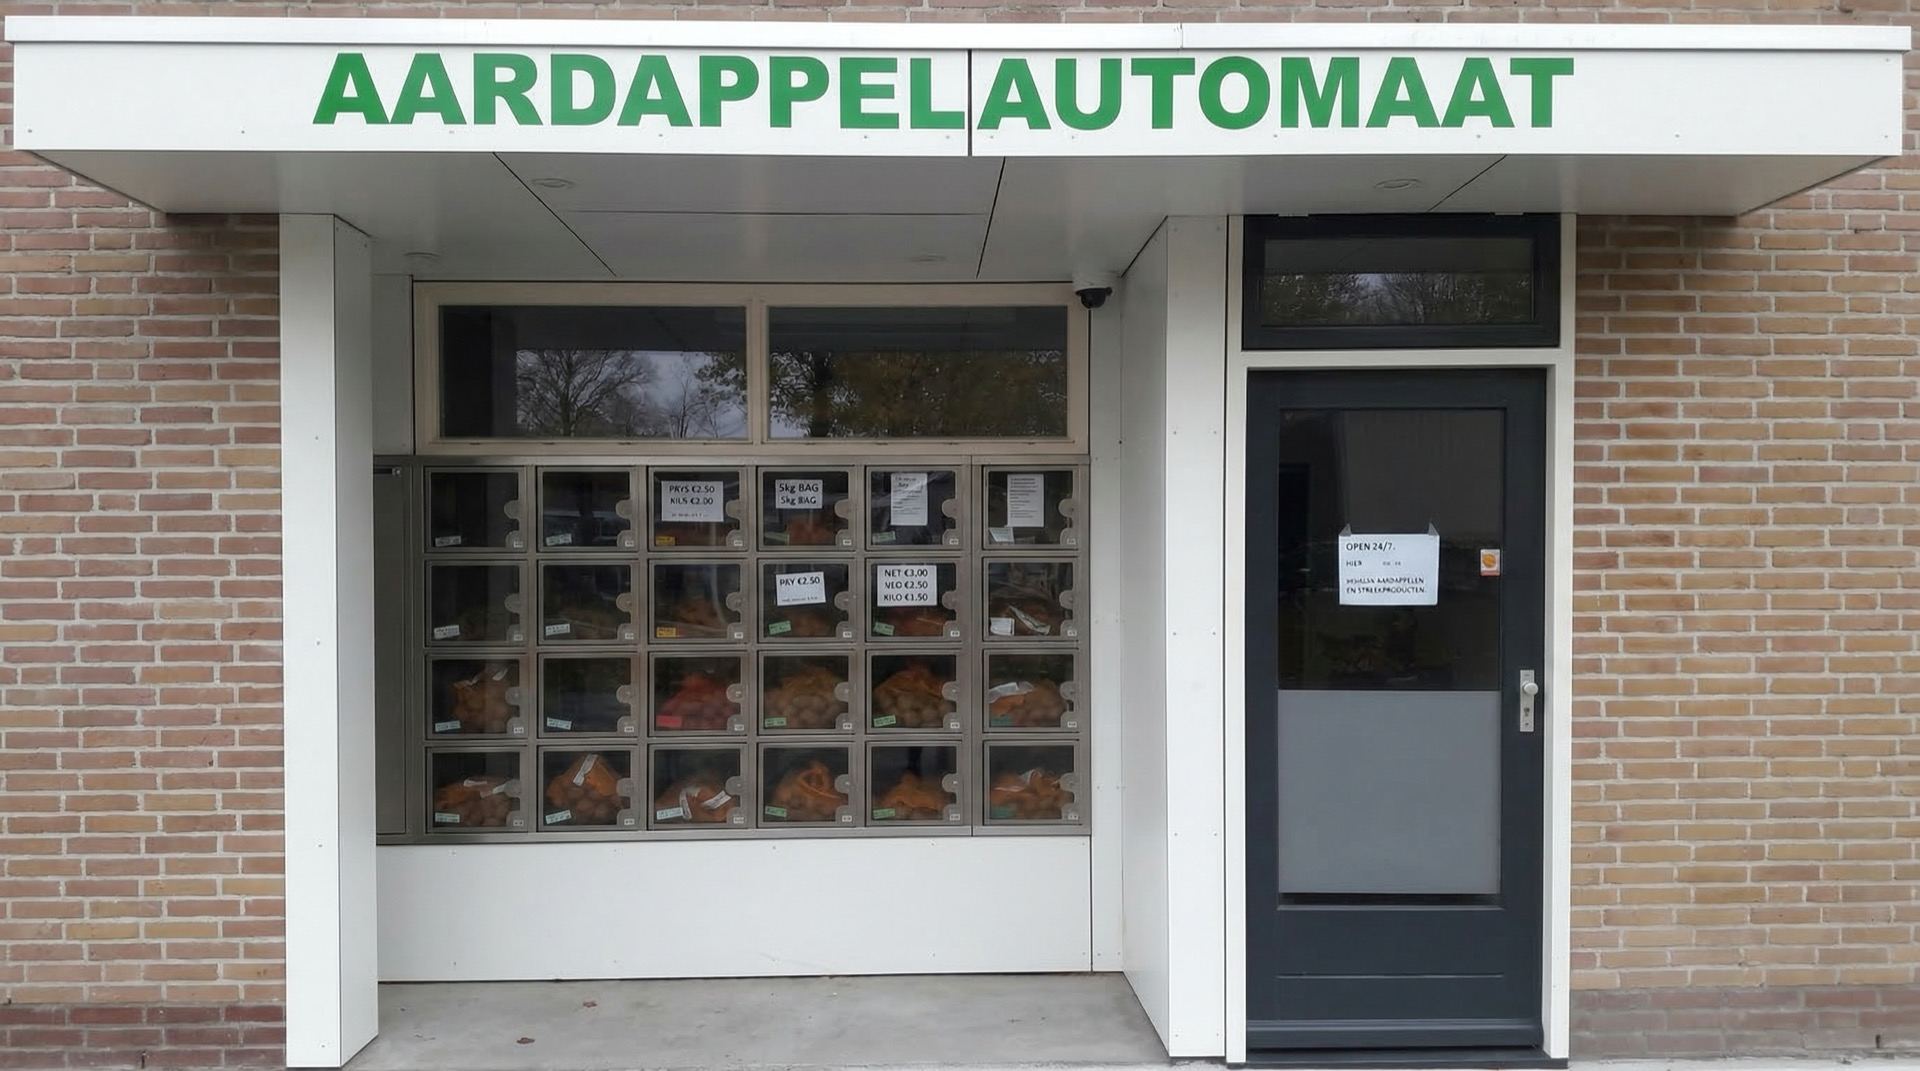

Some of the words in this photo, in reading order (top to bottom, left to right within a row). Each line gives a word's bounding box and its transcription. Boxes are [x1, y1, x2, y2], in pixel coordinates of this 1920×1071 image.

[312, 52, 1575, 130] AARDAPPELAUTOMAAT
[779, 483, 796, 494] 5kg
[798, 483, 819, 493] BAG
[1345, 542, 1371, 551] OPEN
[884, 568, 901, 577] NET
